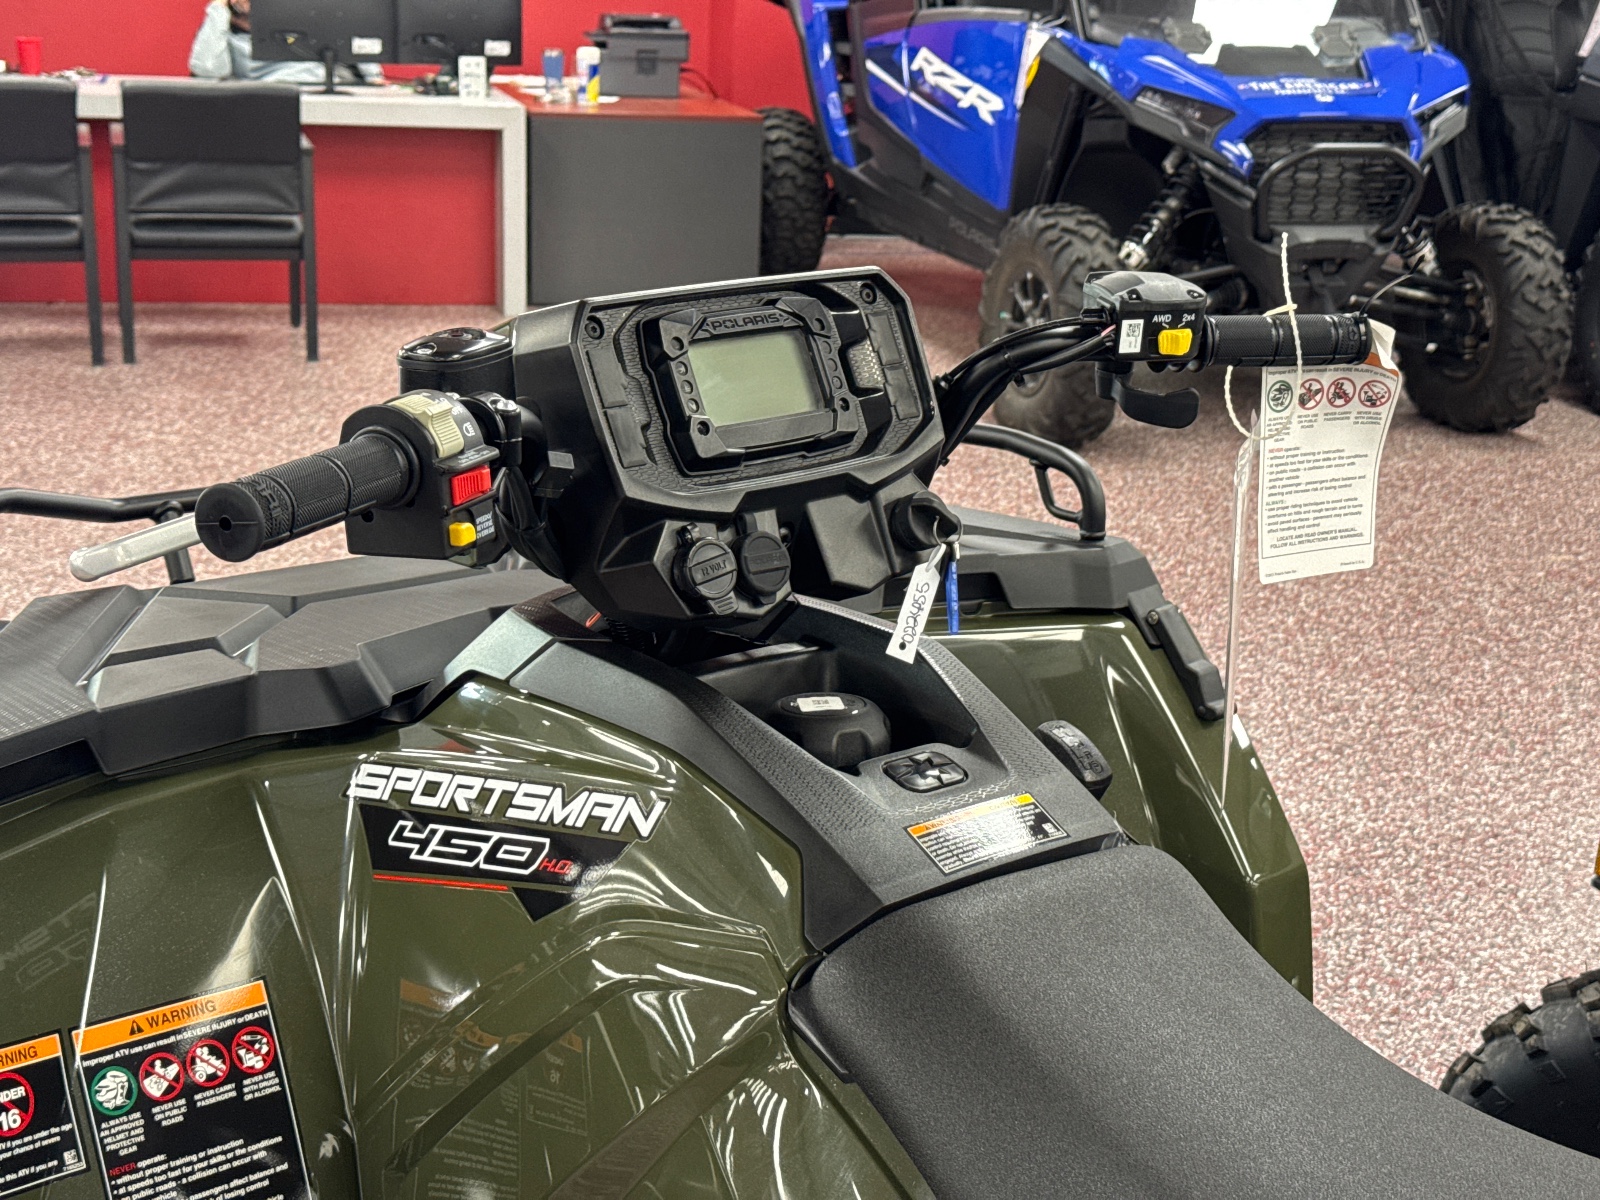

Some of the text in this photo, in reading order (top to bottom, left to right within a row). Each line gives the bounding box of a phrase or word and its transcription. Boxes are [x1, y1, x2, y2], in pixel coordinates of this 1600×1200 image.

[910, 46, 1005, 126] RZR
[711, 313, 781, 331] POLARIS
[1152, 313, 1195, 323] AWD 2x4
[701, 560, 727, 576] 12 VOLT
[346, 763, 668, 840] SPORTSMAN
[388, 819, 550, 875] 450
[146, 1000, 217, 1028] WARNING
[82, 1054, 114, 1067] Improper
[115, 1048, 129, 1058] ATV
[130, 1046, 143, 1054] use
[144, 1041, 156, 1050] can
[157, 1035, 176, 1046] result
[183, 1026, 211, 1039] SEVERE
[212, 1018, 237, 1030] INJURY
[244, 1009, 268, 1021] DEATH
[0, 1046, 38, 1066] RNING
[194, 1082, 236, 1100] NEVER CARRY
[196, 1090, 237, 1108] PASSENGERS
[151, 1098, 186, 1113] NEVER USE
[165, 1106, 188, 1118] PUBLIC
[0, 1108, 21, 1132] 16
[101, 1111, 142, 1129] ALWAYS USE
[110, 1119, 145, 1134] APPROVED
[161, 1115, 184, 1126] ROADS
[12, 1139, 22, 1148] you
[33, 1130, 50, 1140] under
[60, 1123, 72, 1132] age
[103, 1127, 144, 1144] HELMET AND
[105, 1134, 145, 1152] PROTECTIVE
[13, 1144, 34, 1155] chance
[42, 1136, 61, 1146] severe
[118, 1145, 138, 1156] GEAR
[109, 1154, 168, 1176] NEVER operate:
[116, 1170, 144, 1184] without
[145, 1163, 169, 1177] proper
[170, 1153, 198, 1168] training
[207, 1139, 244, 1155] instruction
[118, 1187, 126, 1195] at
[127, 1178, 154, 1192] speeds
[154, 1174, 167, 1182] too
[167, 1169, 181, 1178] fast
[182, 1165, 192, 1173] for
[193, 1160, 208, 1171] your
[209, 1154, 226, 1165] skills
[235, 1147, 246, 1156] the
[247, 1136, 283, 1152] conditions
[5, 1173, 17, 1181] this
[18, 1168, 30, 1177] ATV
[36, 1164, 47, 1173] you
[132, 1188, 155, 1200] public
[156, 1180, 177, 1192] roads
[187, 1167, 217, 1182] collision
[218, 1163, 231, 1172] can
[232, 1156, 251, 1167] occur
[252, 1150, 267, 1160] with
[230, 1176, 248, 1188] affect
[249, 1168, 274, 1182] balance
[276, 1162, 288, 1172] and
[224, 1188, 245, 1200] losing
[246, 1178, 269, 1192] control
